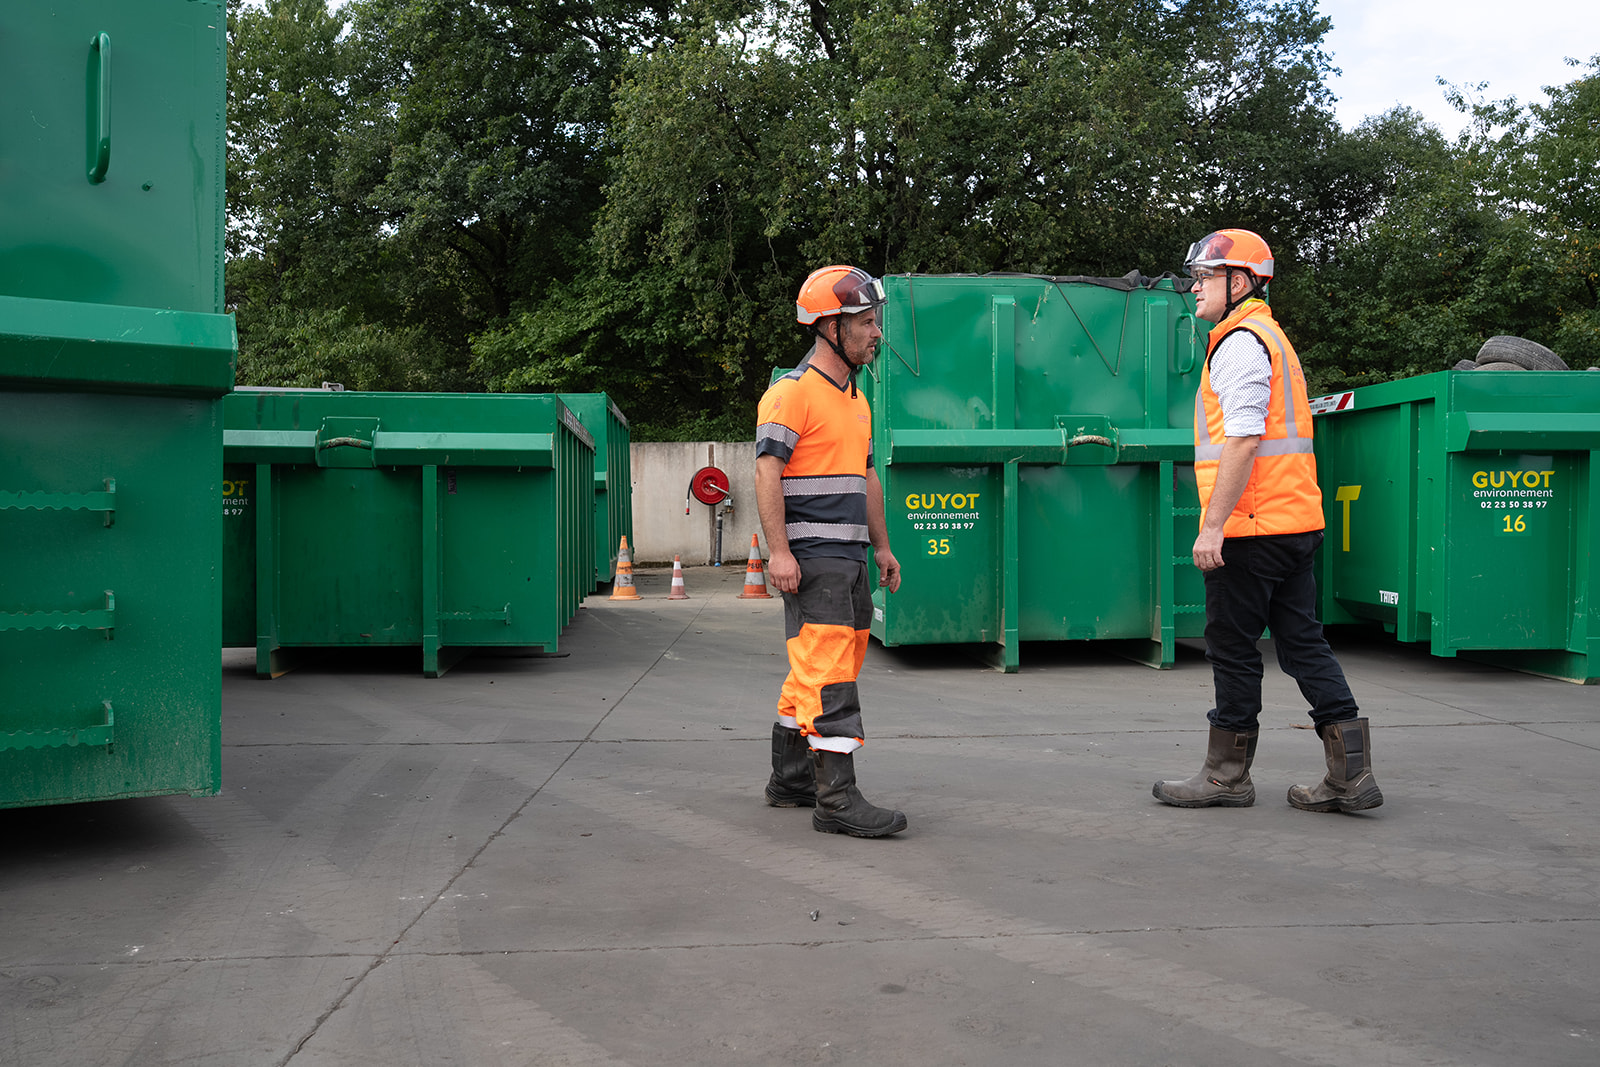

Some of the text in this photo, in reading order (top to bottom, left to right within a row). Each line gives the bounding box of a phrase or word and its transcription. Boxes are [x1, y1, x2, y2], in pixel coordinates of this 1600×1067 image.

[1472, 470, 1556, 488] GUYOT
[222, 480, 249, 496] OT
[1473, 488, 1554, 498] environnement
[222, 497, 249, 506] ment
[905, 493, 980, 510] GUYOT
[1480, 500, 1548, 509] 02 23 50 38 97
[222, 508, 243, 516] 8 97
[907, 511, 980, 520] environnement
[913, 522, 975, 530] 02 23 50 38 97
[1502, 514, 1527, 533] 16
[927, 538, 950, 555] 35
[1379, 590, 1399, 605] THIEV
